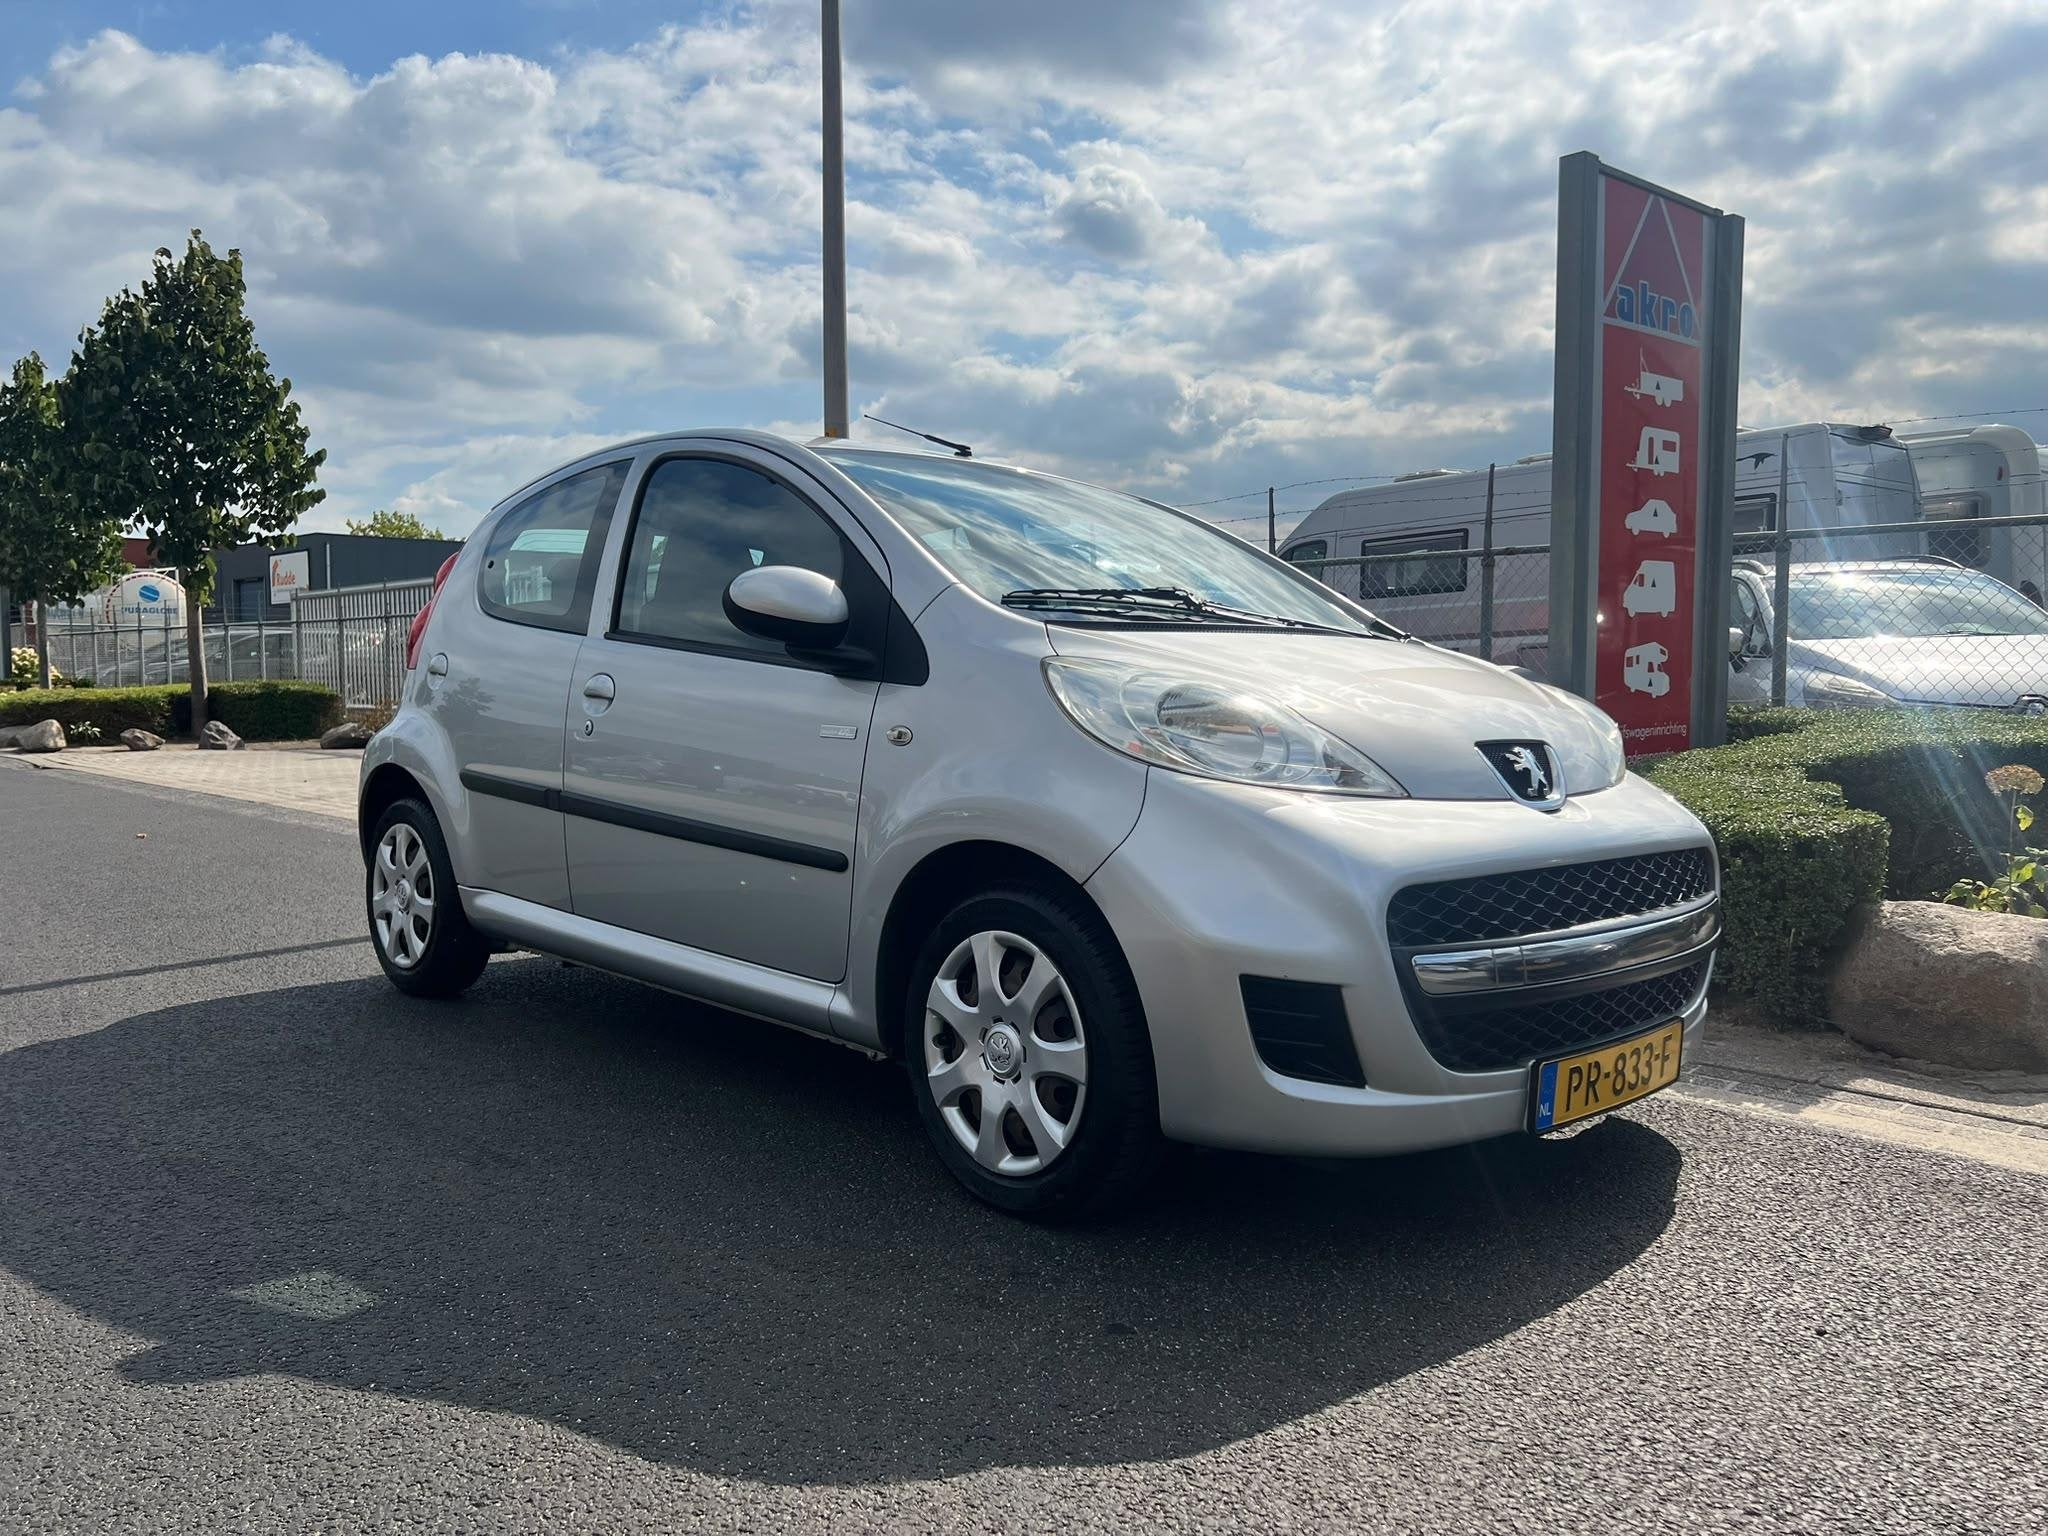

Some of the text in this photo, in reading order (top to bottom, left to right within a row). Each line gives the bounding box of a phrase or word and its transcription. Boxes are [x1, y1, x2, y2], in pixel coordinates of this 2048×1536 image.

[1615, 280, 1694, 338] akro
[1566, 1034, 1672, 1112] PR-833-F
[1539, 1103, 1551, 1117] NL
